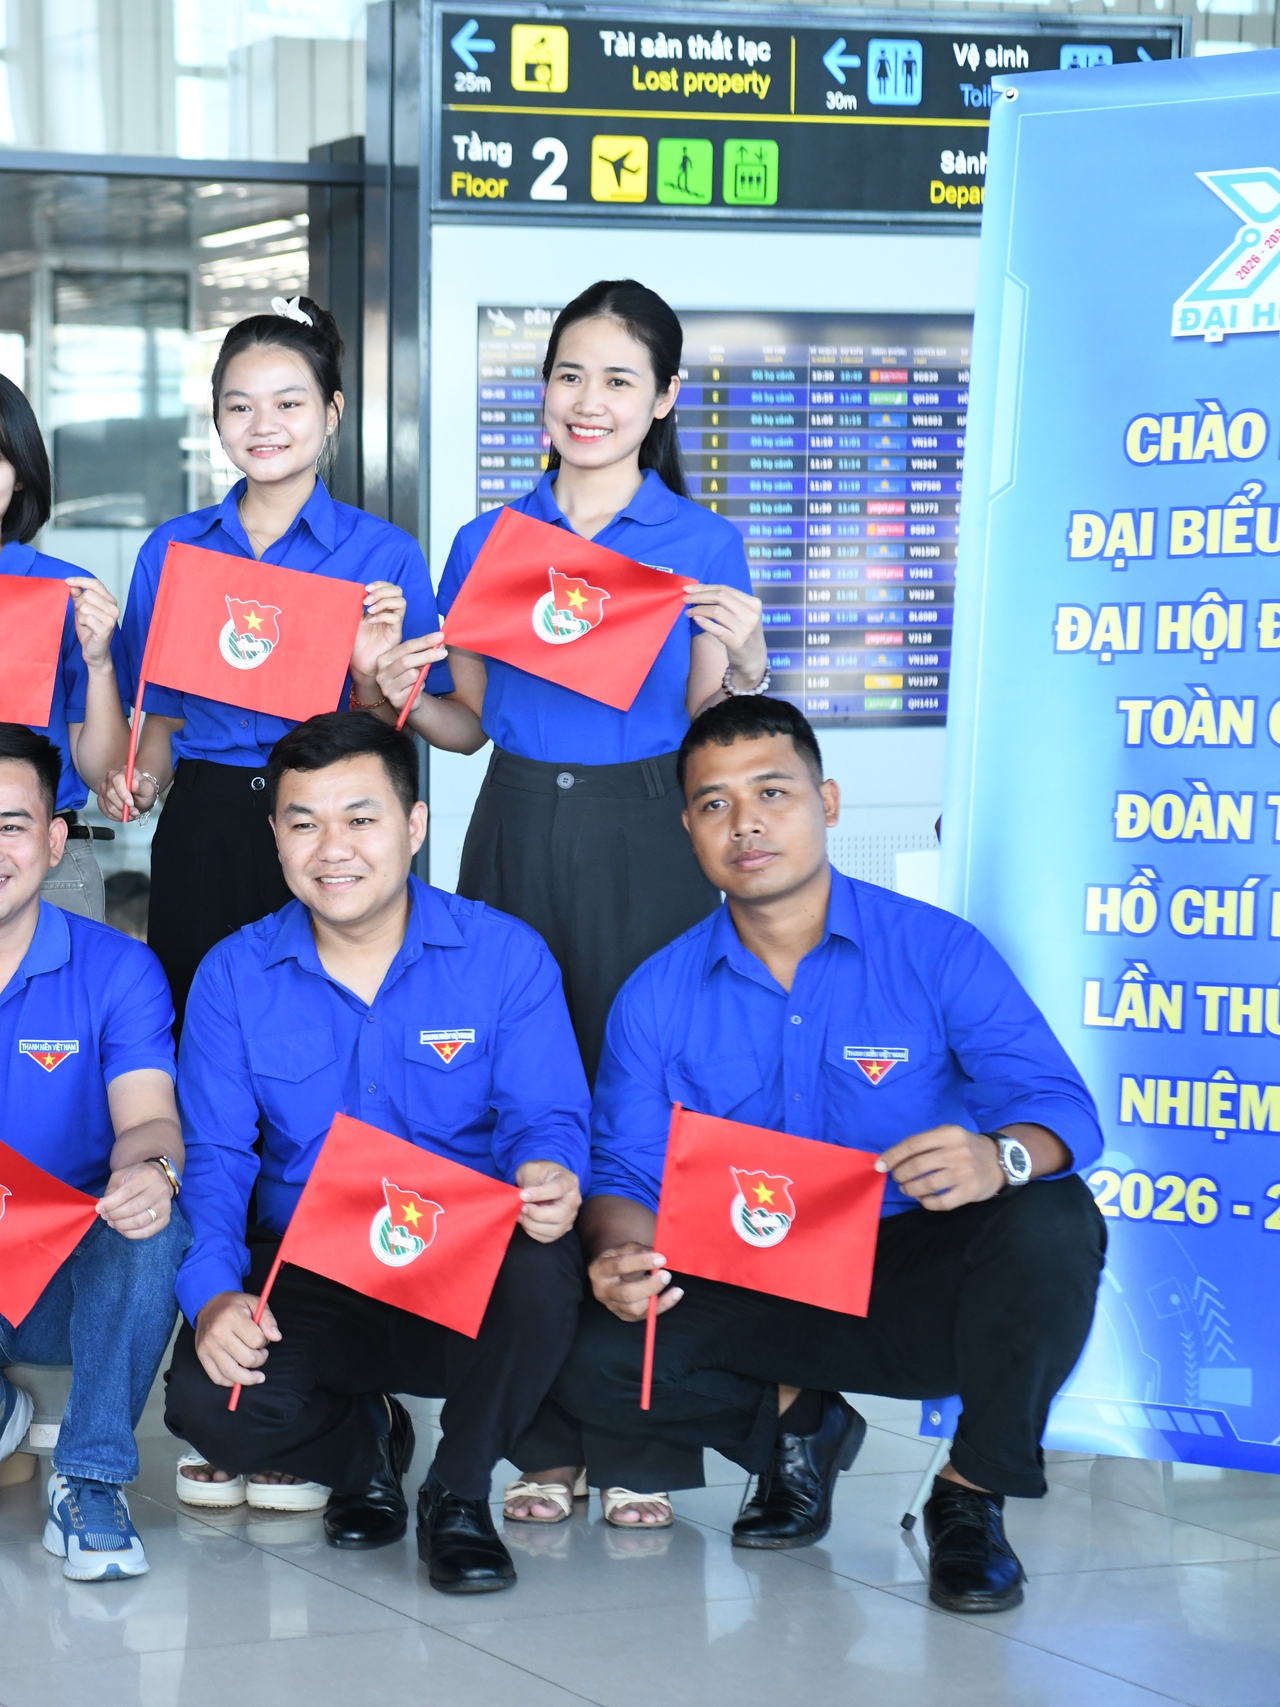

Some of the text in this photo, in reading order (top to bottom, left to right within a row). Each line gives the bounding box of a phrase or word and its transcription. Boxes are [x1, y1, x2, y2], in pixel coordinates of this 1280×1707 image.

[599, 29, 772, 66] Tài sản thất lạc
[952, 42, 1030, 72] Vệ sinh
[453, 71, 492, 93] 25m
[632, 64, 772, 100] Lost property
[825, 90, 858, 111] 30m
[452, 130, 568, 200] Tầng 2
[450, 171, 509, 199] Floor
[1235, 254, 1261, 281] 2026
[1178, 304, 1239, 337] ĐẠI
[810, 414, 834, 426] 11:05
[1125, 401, 1267, 465] CHÀO
[810, 436, 834, 448] 11:10
[810, 458, 833, 470] 11:10
[710, 479, 718, 492] A
[1068, 511, 1155, 568] ĐẠI
[1055, 605, 1142, 662] ĐẠI
[1156, 591, 1244, 661] HỘI
[1118, 686, 1255, 746] TOÀN
[1115, 781, 1253, 841] ĐOÀN
[1084, 867, 1263, 938] HỒ CHÍ
[1083, 962, 1183, 1031] LẦN
[1120, 1069, 1280, 1141] NHIỆM
[1089, 1169, 1219, 1225] 2026
